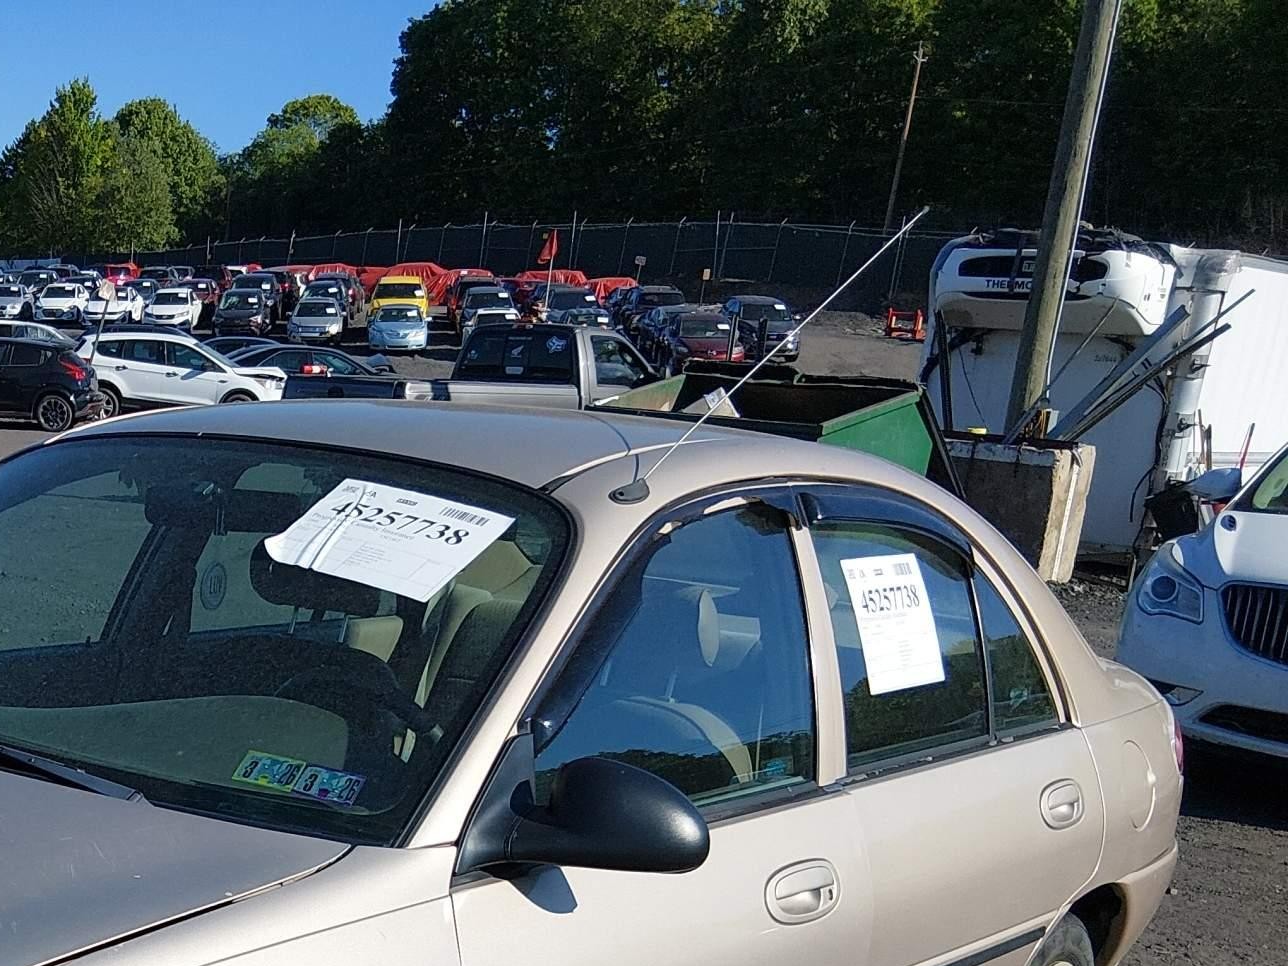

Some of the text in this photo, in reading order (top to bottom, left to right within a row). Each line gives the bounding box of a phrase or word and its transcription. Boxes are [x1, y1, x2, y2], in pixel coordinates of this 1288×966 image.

[331, 500, 471, 546] 45257738
[861, 584, 920, 613] 45257738
[242, 760, 298, 786] 3 26
[303, 773, 361, 801] 3 26
